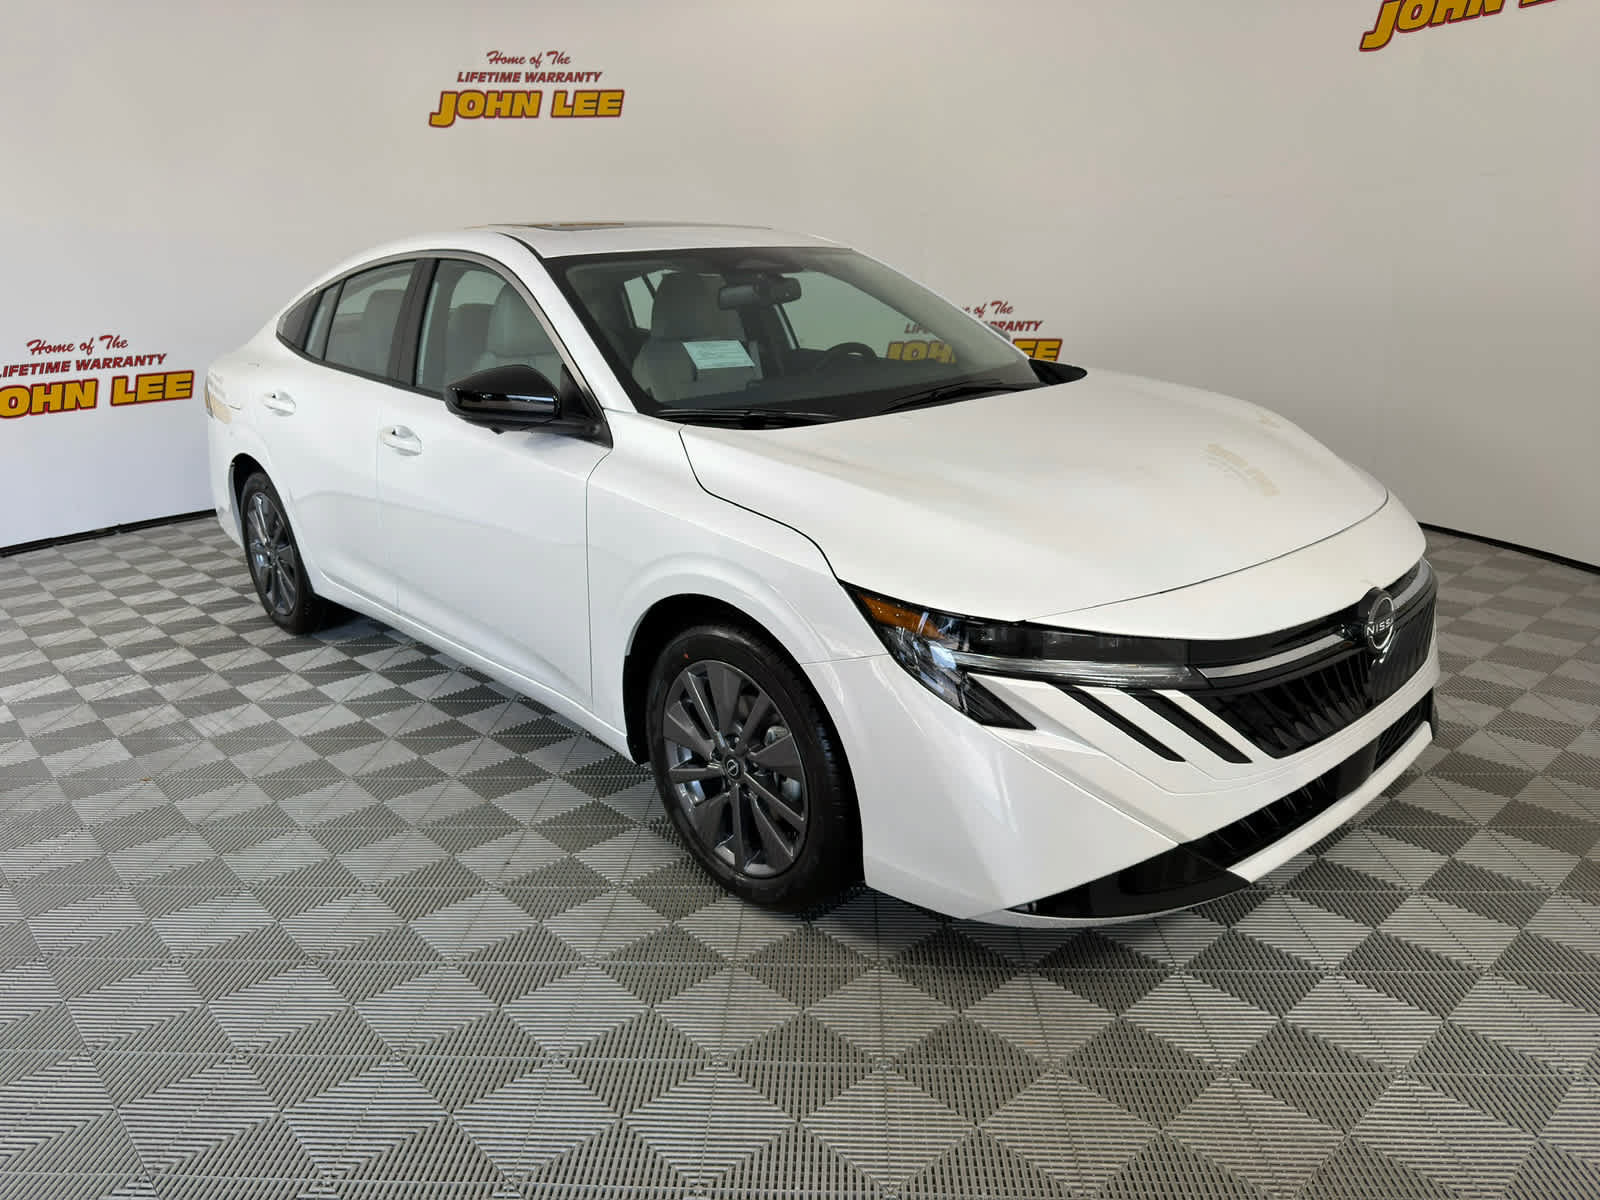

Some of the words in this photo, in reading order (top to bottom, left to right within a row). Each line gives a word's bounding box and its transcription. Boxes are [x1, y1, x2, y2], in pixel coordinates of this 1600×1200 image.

[487, 50, 526, 65] Home
[530, 52, 542, 68] of
[547, 50, 571, 65] The
[457, 71, 521, 83] LIFETIME
[525, 71, 602, 83] WARRANTY
[429, 89, 543, 128] JOHN
[550, 89, 625, 119] LEE
[990, 300, 1014, 315] The
[26, 339, 74, 356] Home
[79, 337, 95, 356] of
[99, 334, 129, 350] The
[76, 353, 167, 372] WARRANTY
[0, 378, 98, 420] OHN
[110, 370, 195, 407] LEE
[1366, 617, 1392, 637] NISS
